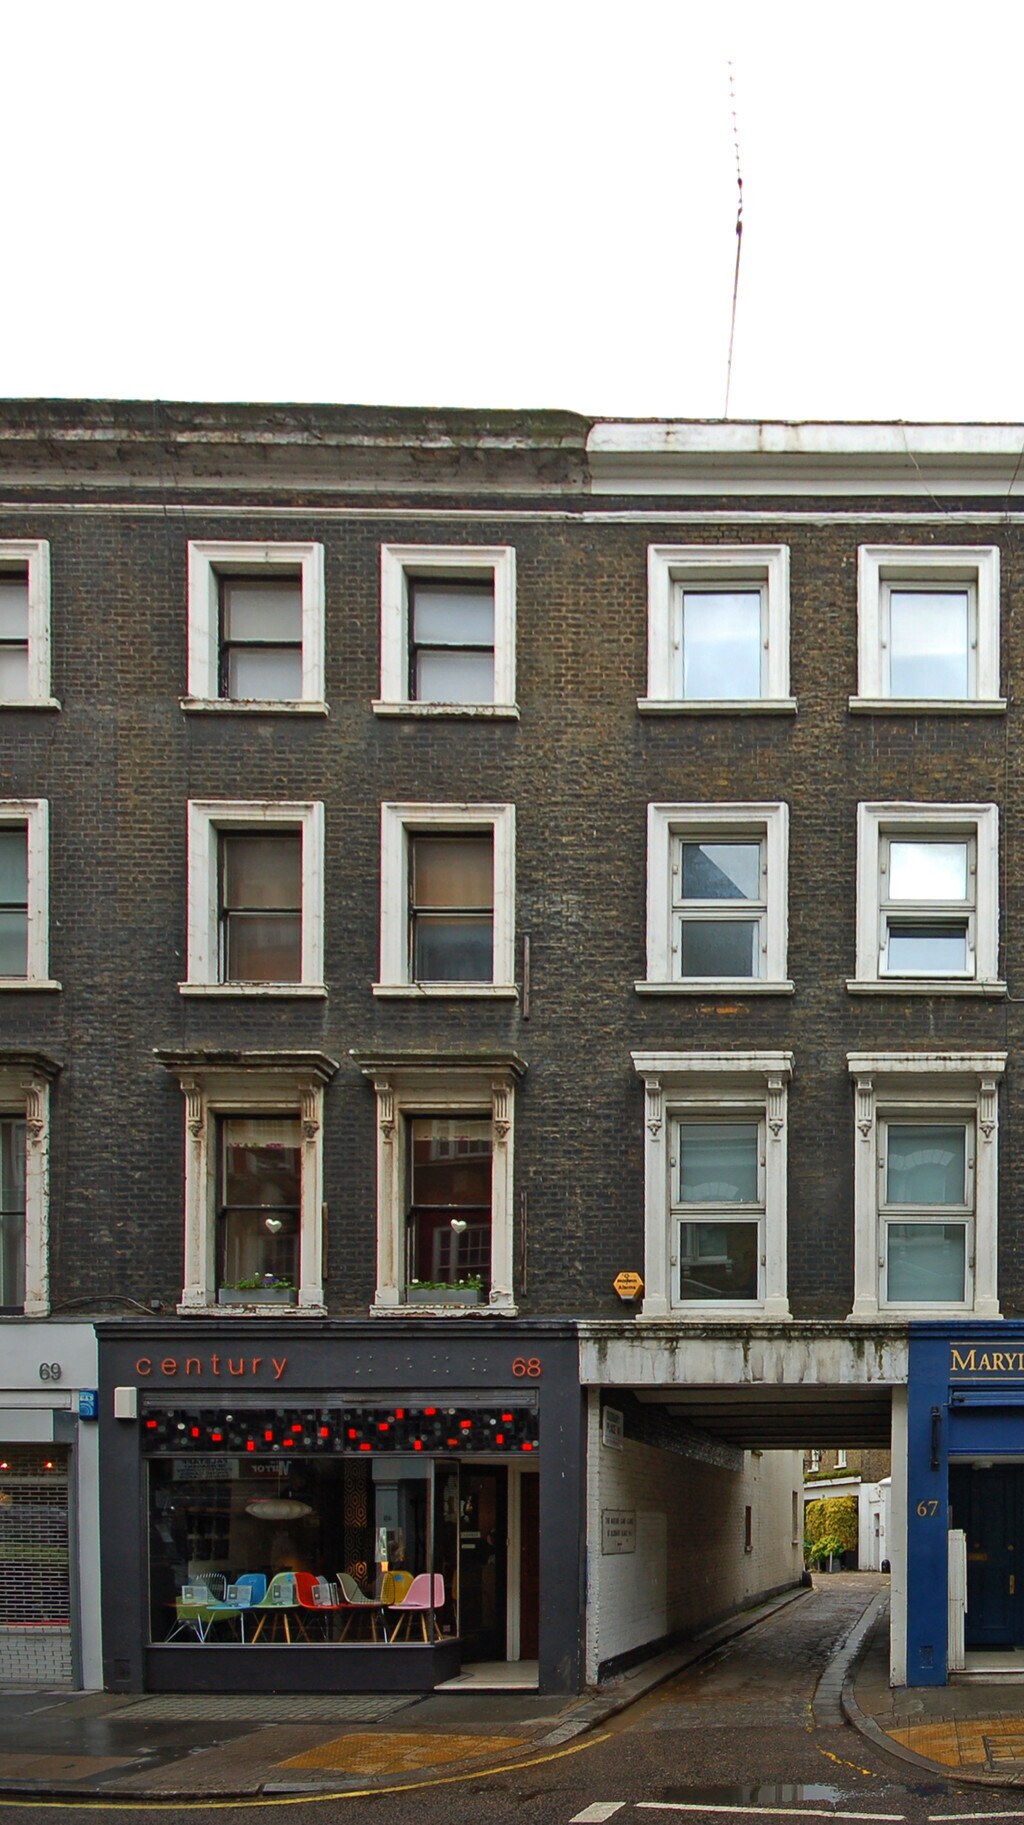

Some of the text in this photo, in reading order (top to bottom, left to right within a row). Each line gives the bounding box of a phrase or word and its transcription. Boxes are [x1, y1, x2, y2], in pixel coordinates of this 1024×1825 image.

[39, 1362, 62, 1381] 69
[136, 1355, 288, 1380] century
[512, 1358, 541, 1378] 68
[916, 1500, 938, 1517] 67
